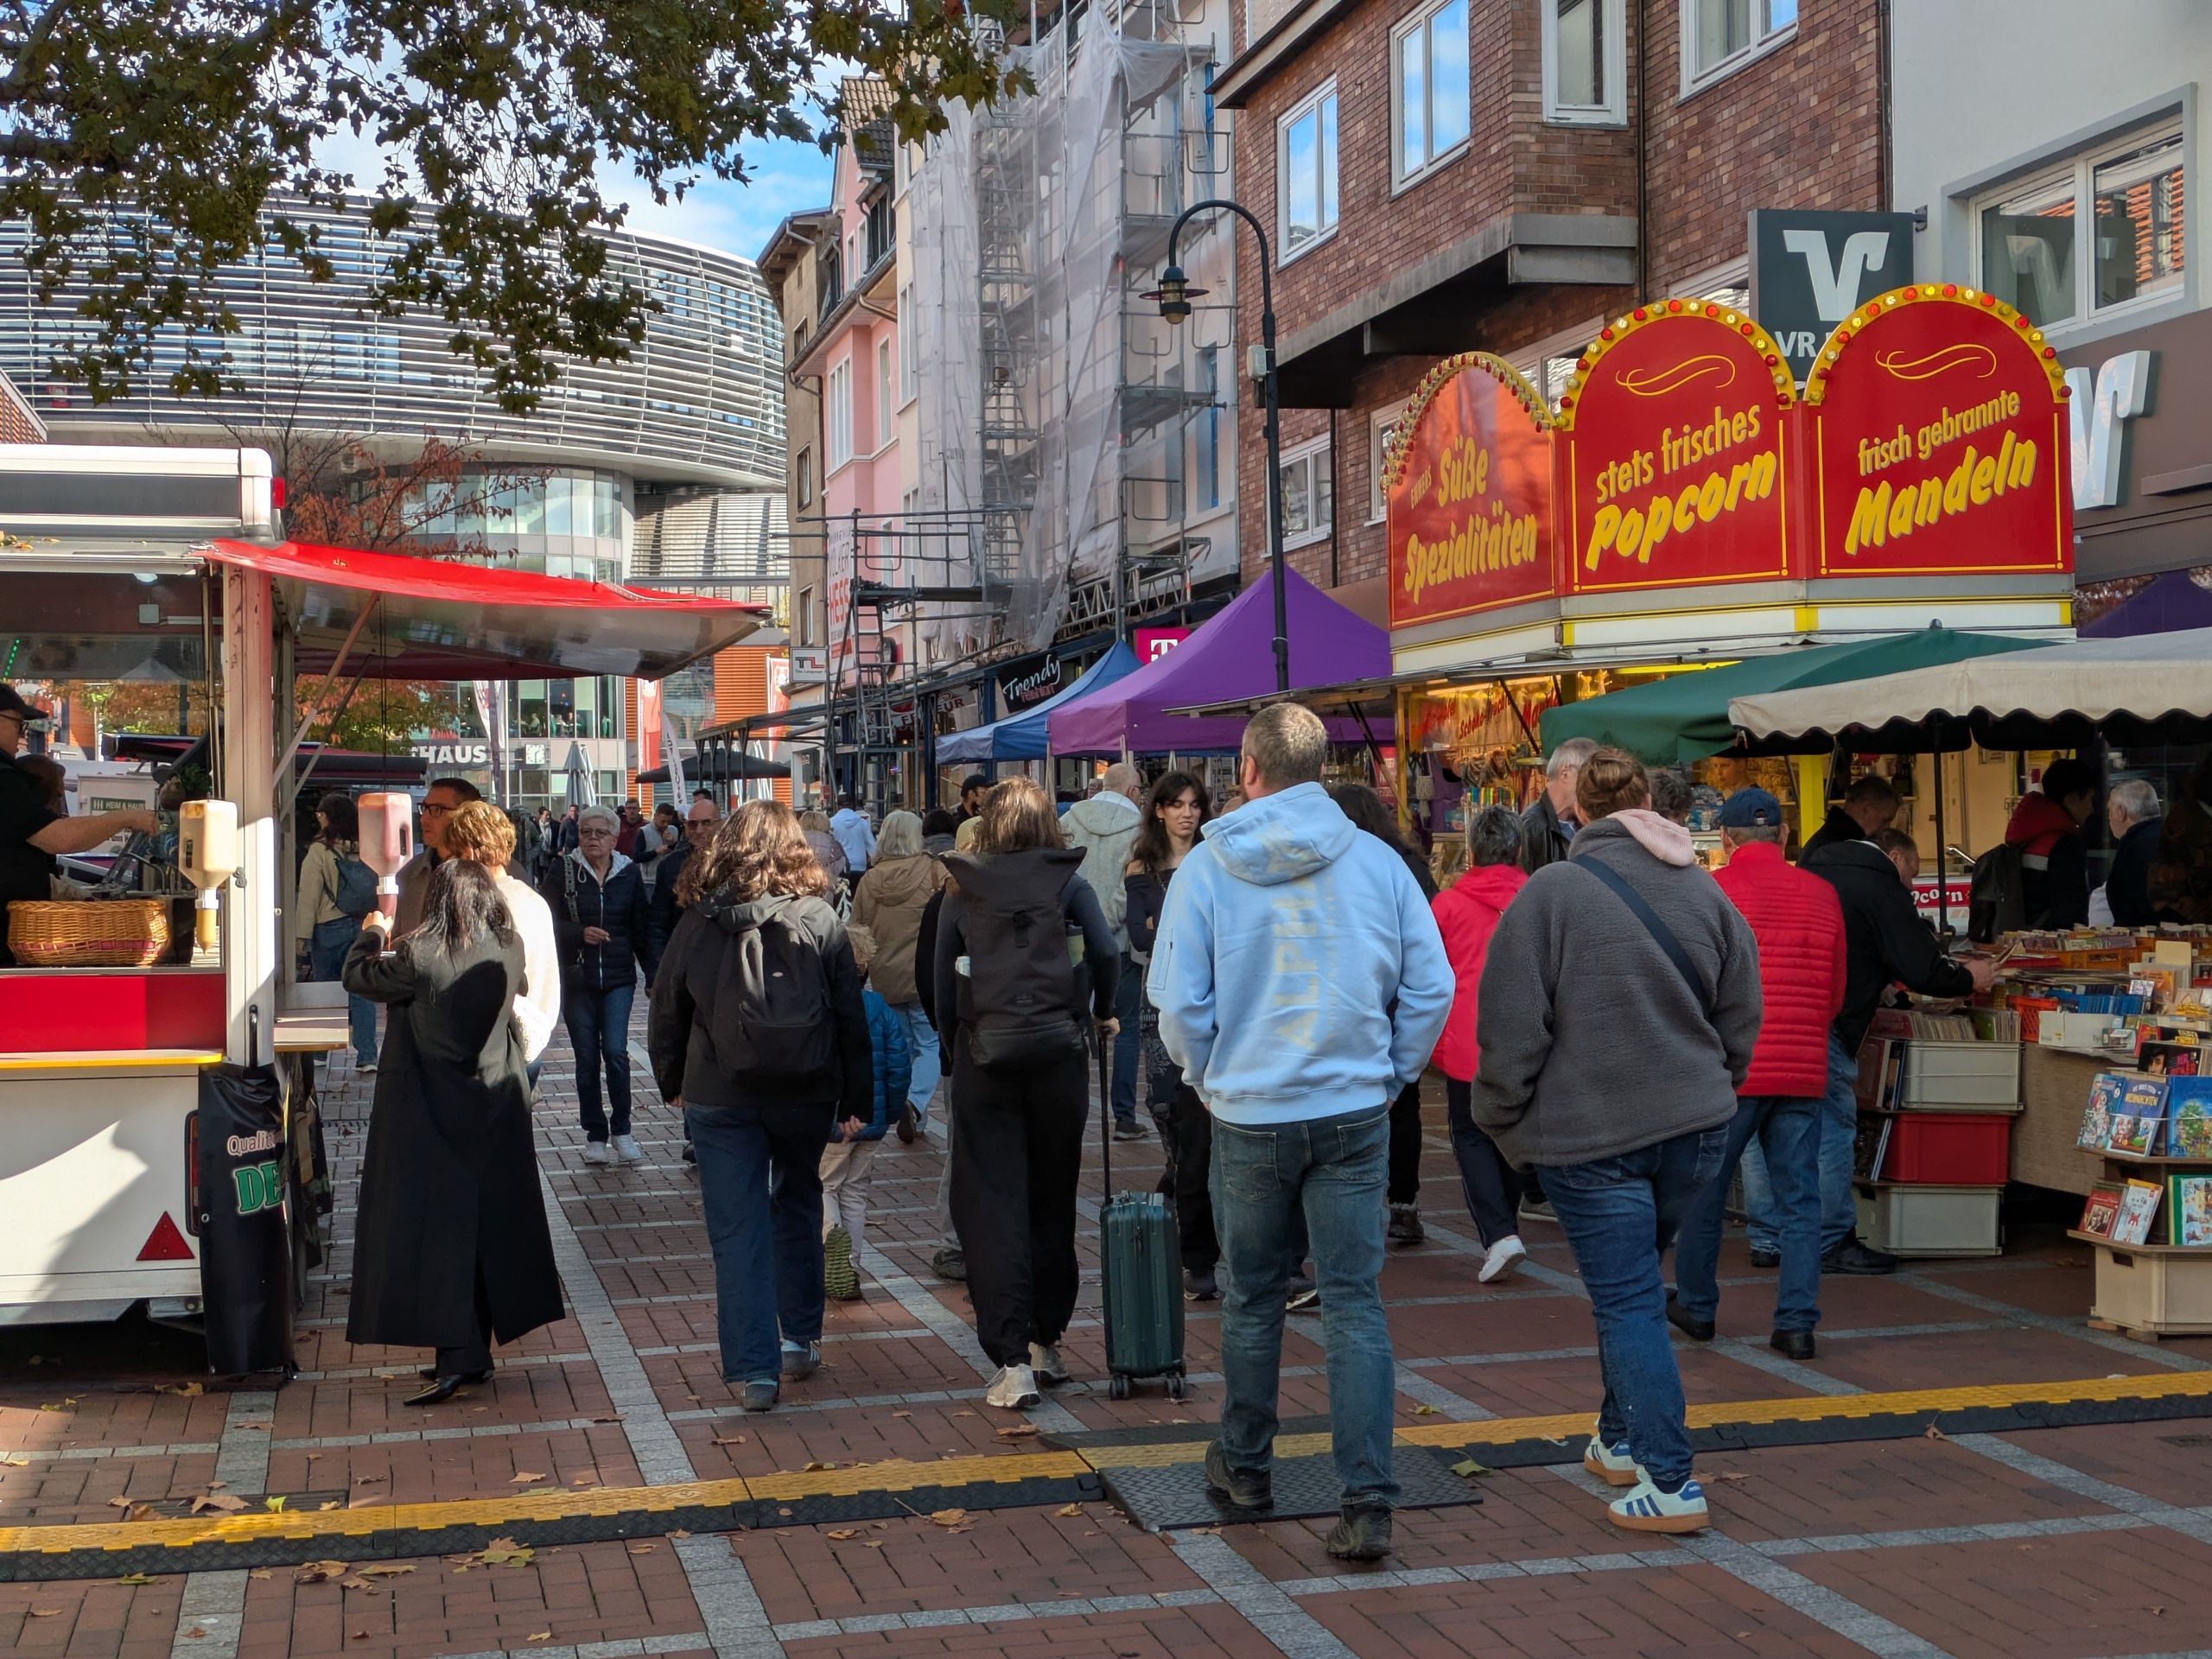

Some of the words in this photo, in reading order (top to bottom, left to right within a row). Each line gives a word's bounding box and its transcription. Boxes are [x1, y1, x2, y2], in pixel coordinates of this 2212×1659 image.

[1775, 331, 1816, 357] VR
[1438, 435, 1489, 507] Süße
[1597, 449, 1654, 504] stets
[1662, 404, 1760, 474] frisches
[1858, 423, 1912, 476] frisch
[1917, 390, 2020, 461] gebrannte
[1585, 450, 1777, 571] Popcorn
[1845, 429, 2037, 556] Mandeln
[1404, 499, 1538, 606] Spezialitäten
[1002, 654, 1061, 700] Trendy
[1273, 874, 1321, 1052] ALPH
